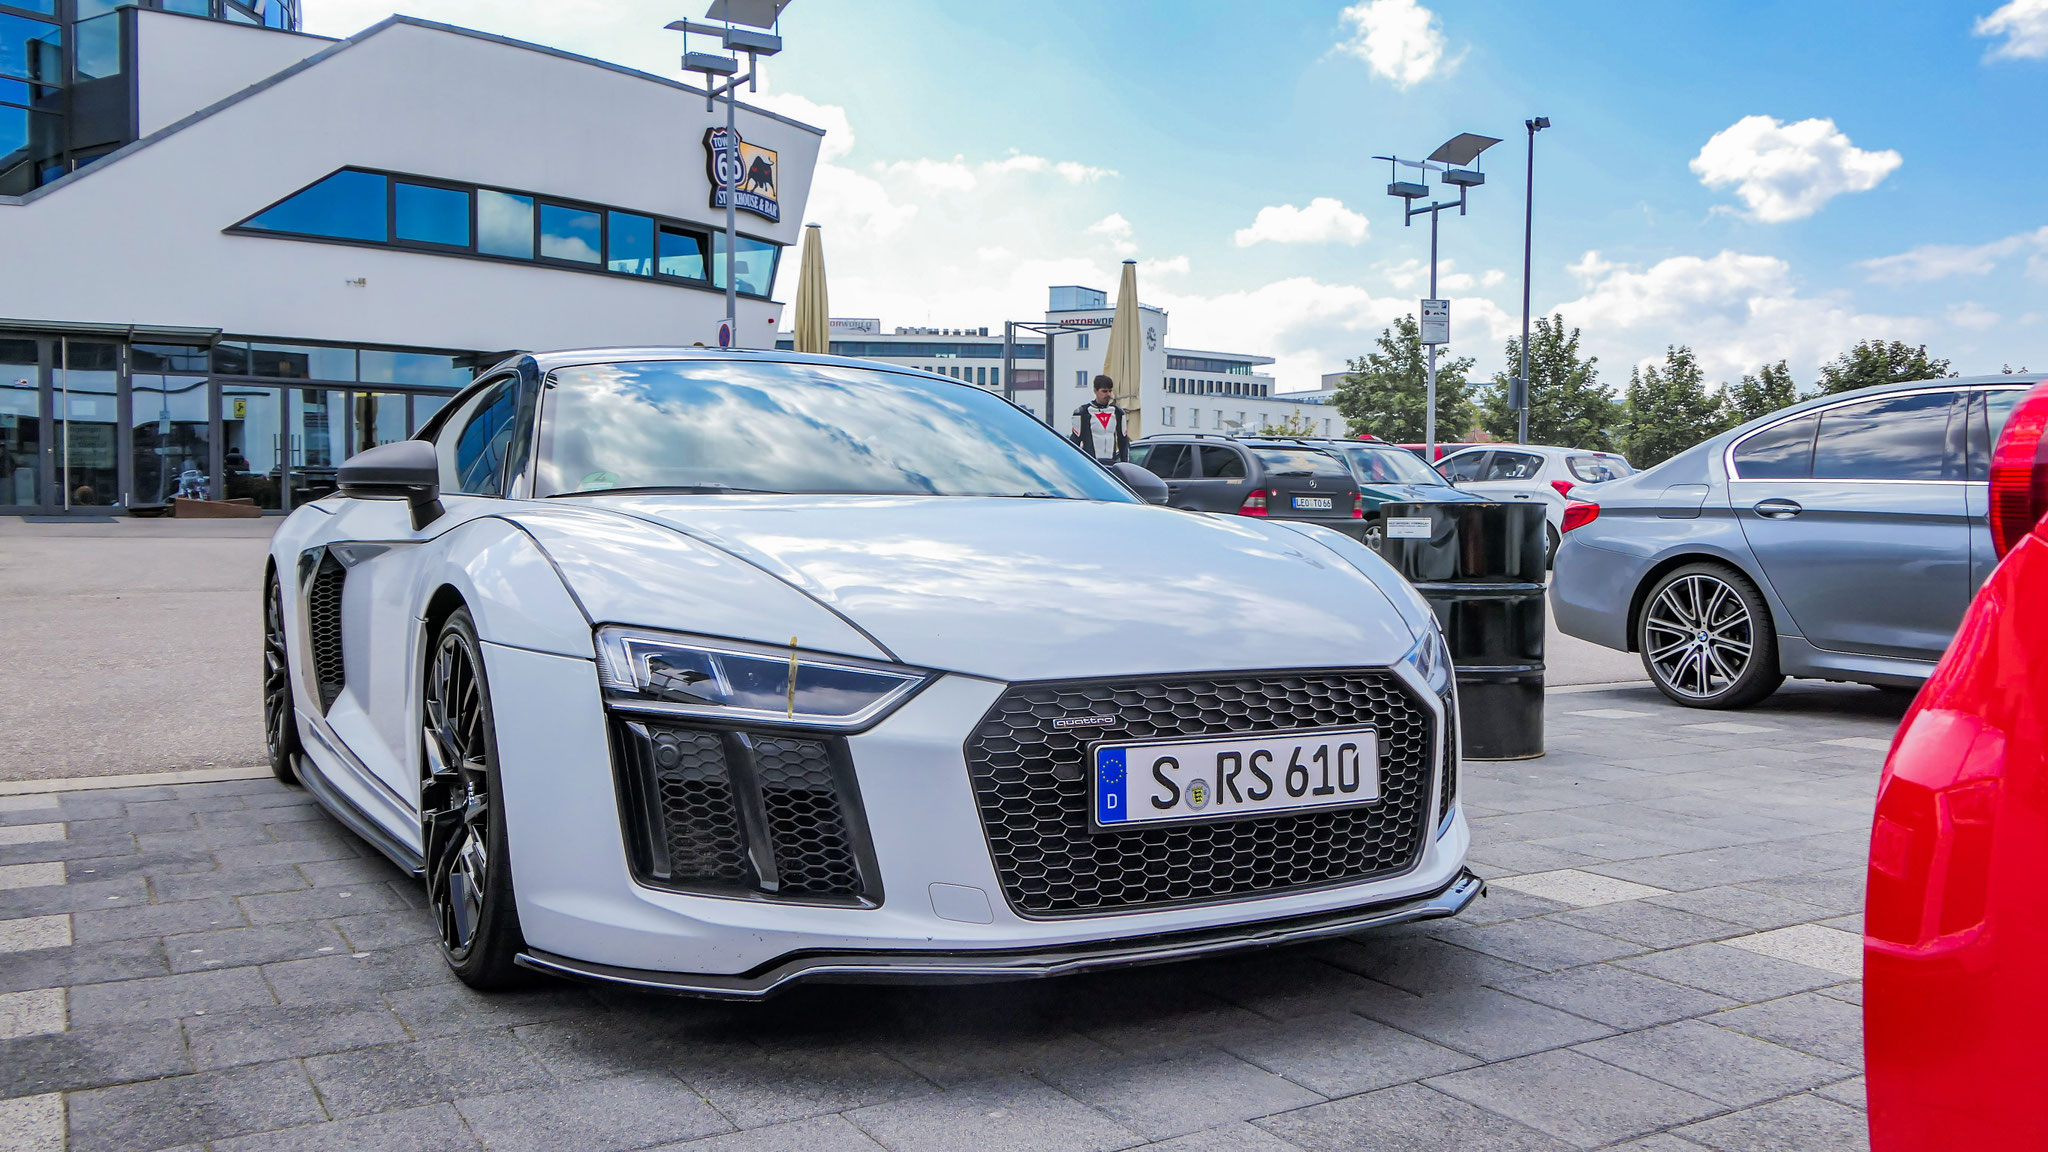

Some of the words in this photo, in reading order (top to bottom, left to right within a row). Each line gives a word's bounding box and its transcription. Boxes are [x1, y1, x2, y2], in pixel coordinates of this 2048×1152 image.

[718, 190, 758, 208] STKHOUSE
[759, 198, 764, 210] &
[764, 200, 777, 217] BAR
[829, 320, 872, 328] ORWORLD
[1060, 317, 1114, 326] MOTORWOR
[1296, 498, 1310, 507] LEO
[1056, 717, 1113, 727] quattro
[1107, 793, 1118, 809] D
[1150, 756, 1181, 810] S
[1215, 749, 1274, 805] RS
[1285, 742, 1360, 798] 610
